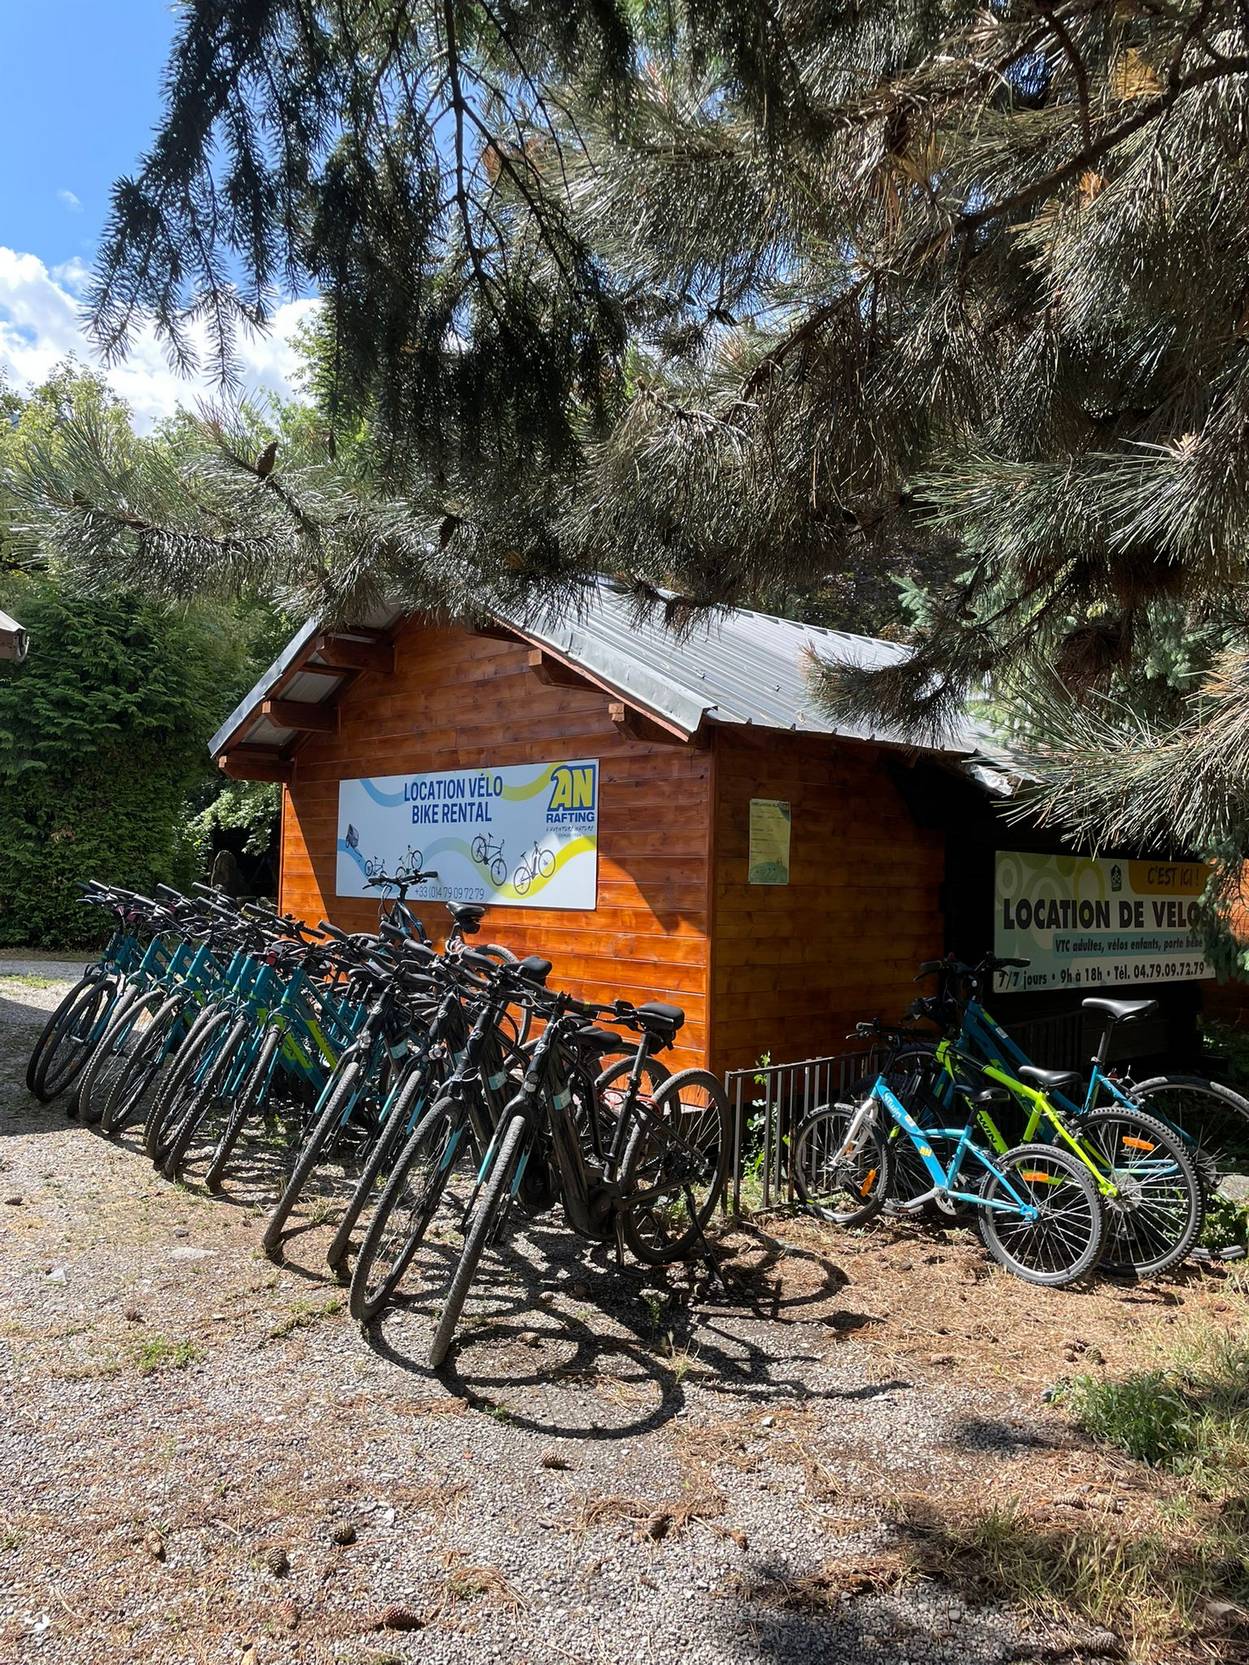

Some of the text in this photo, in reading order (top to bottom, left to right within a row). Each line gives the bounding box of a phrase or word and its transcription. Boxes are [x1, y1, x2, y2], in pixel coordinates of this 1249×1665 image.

[404, 774, 503, 801] LOCATION VÉLO
[549, 766, 597, 811] AN
[412, 802, 492, 824] BIKE RENTAL
[546, 811, 595, 823] RAFTING
[1147, 865, 1177, 887] C'EST
[1180, 868, 1193, 888] ICI
[1003, 898, 1211, 930] LOCATION DE VELO
[1055, 939, 1071, 952] VTC
[1072, 938, 1105, 953] adultes,
[1130, 937, 1162, 951] enfants,
[999, 961, 1205, 989] 7/7 jours 9h à 18h Tél. 04.79.09.72.79
